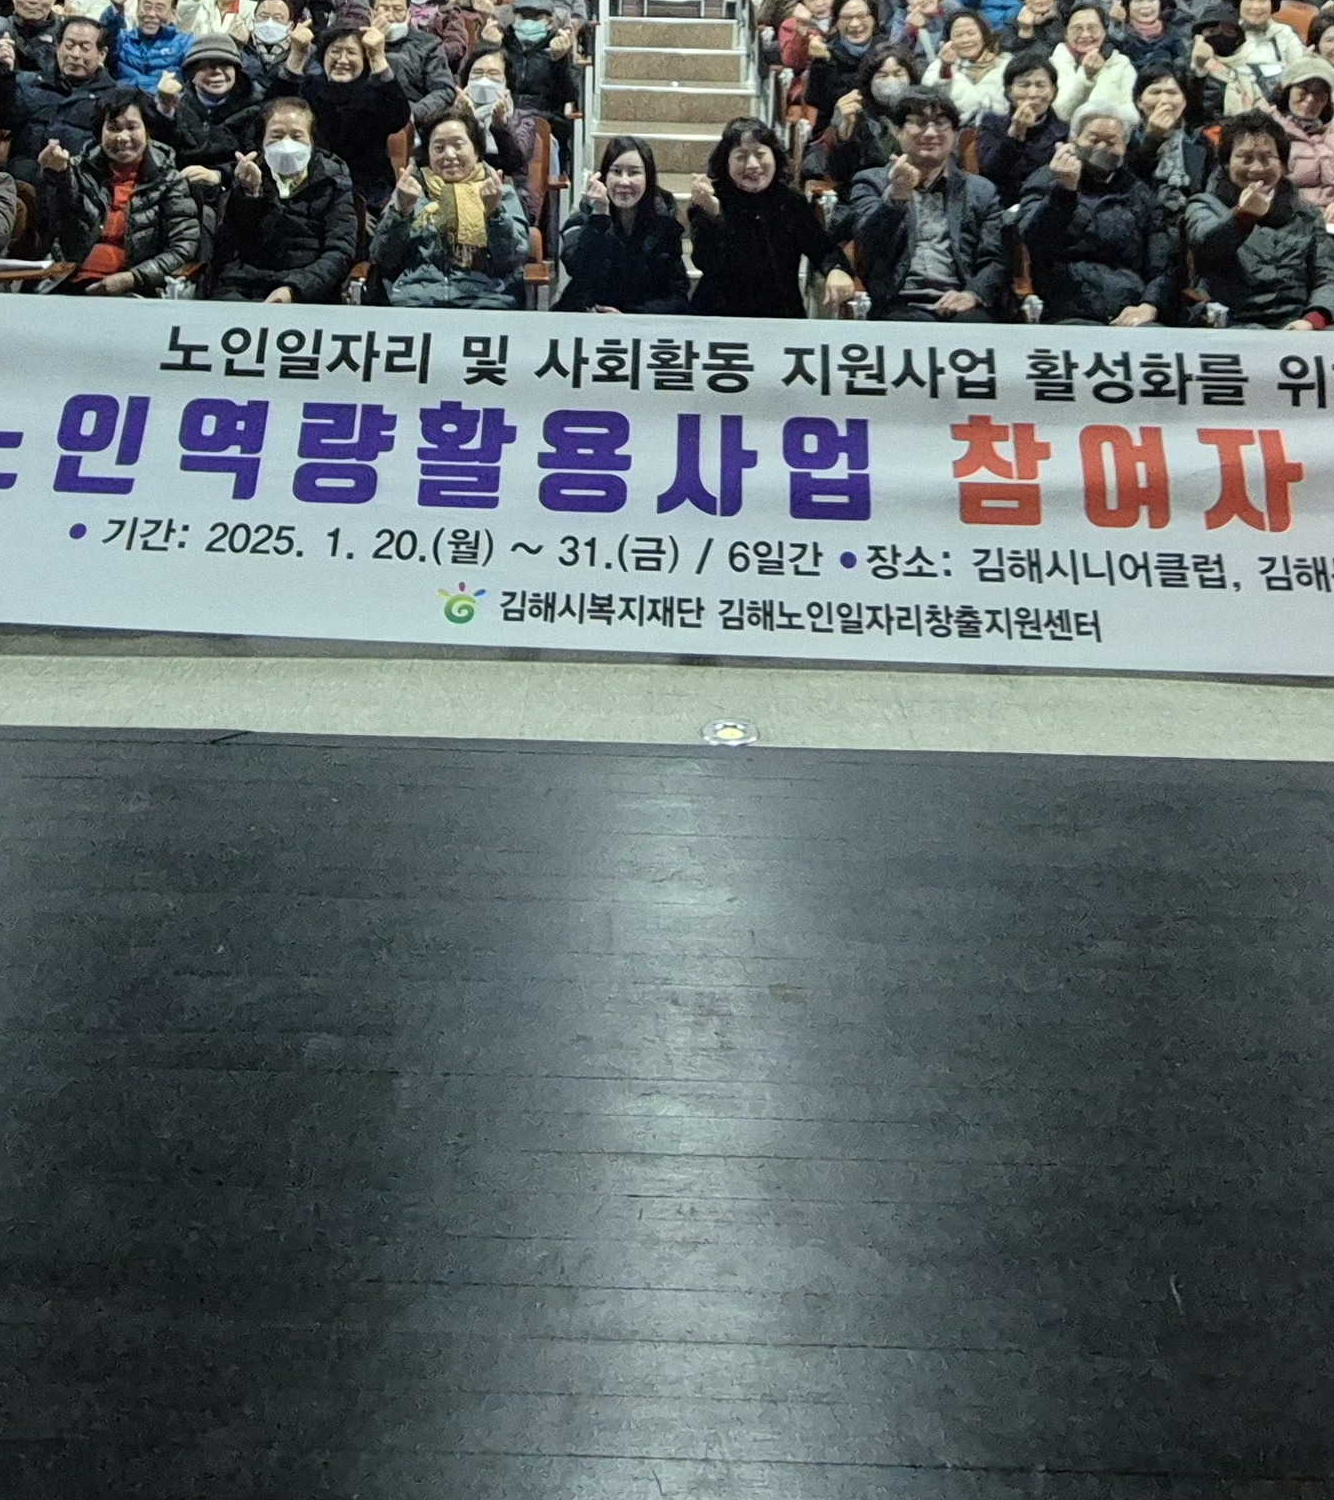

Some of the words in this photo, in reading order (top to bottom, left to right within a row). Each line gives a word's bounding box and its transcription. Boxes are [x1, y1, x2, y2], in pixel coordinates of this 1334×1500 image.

[159, 325, 432, 385] 노인일자리
[462, 334, 509, 387] 및
[534, 336, 755, 394] 사회활동
[781, 343, 997, 400] 지원사업
[1025, 348, 1249, 407] 활성화를
[949, 414, 1305, 533] 참여자
[101, 516, 190, 552] 기간:
[204, 521, 304, 558] 2025.
[327, 527, 354, 560] 1.
[372, 527, 494, 567] 20.(월)
[558, 533, 679, 574] 31.(금)
[728, 540, 824, 577] 6일간
[866, 544, 952, 580] 장소:
[972, 547, 1241, 592] 김해시니어클럽,
[499, 590, 706, 629] 김해시복지재단
[718, 598, 1102, 643] 김해노인일자리창출지원센터
